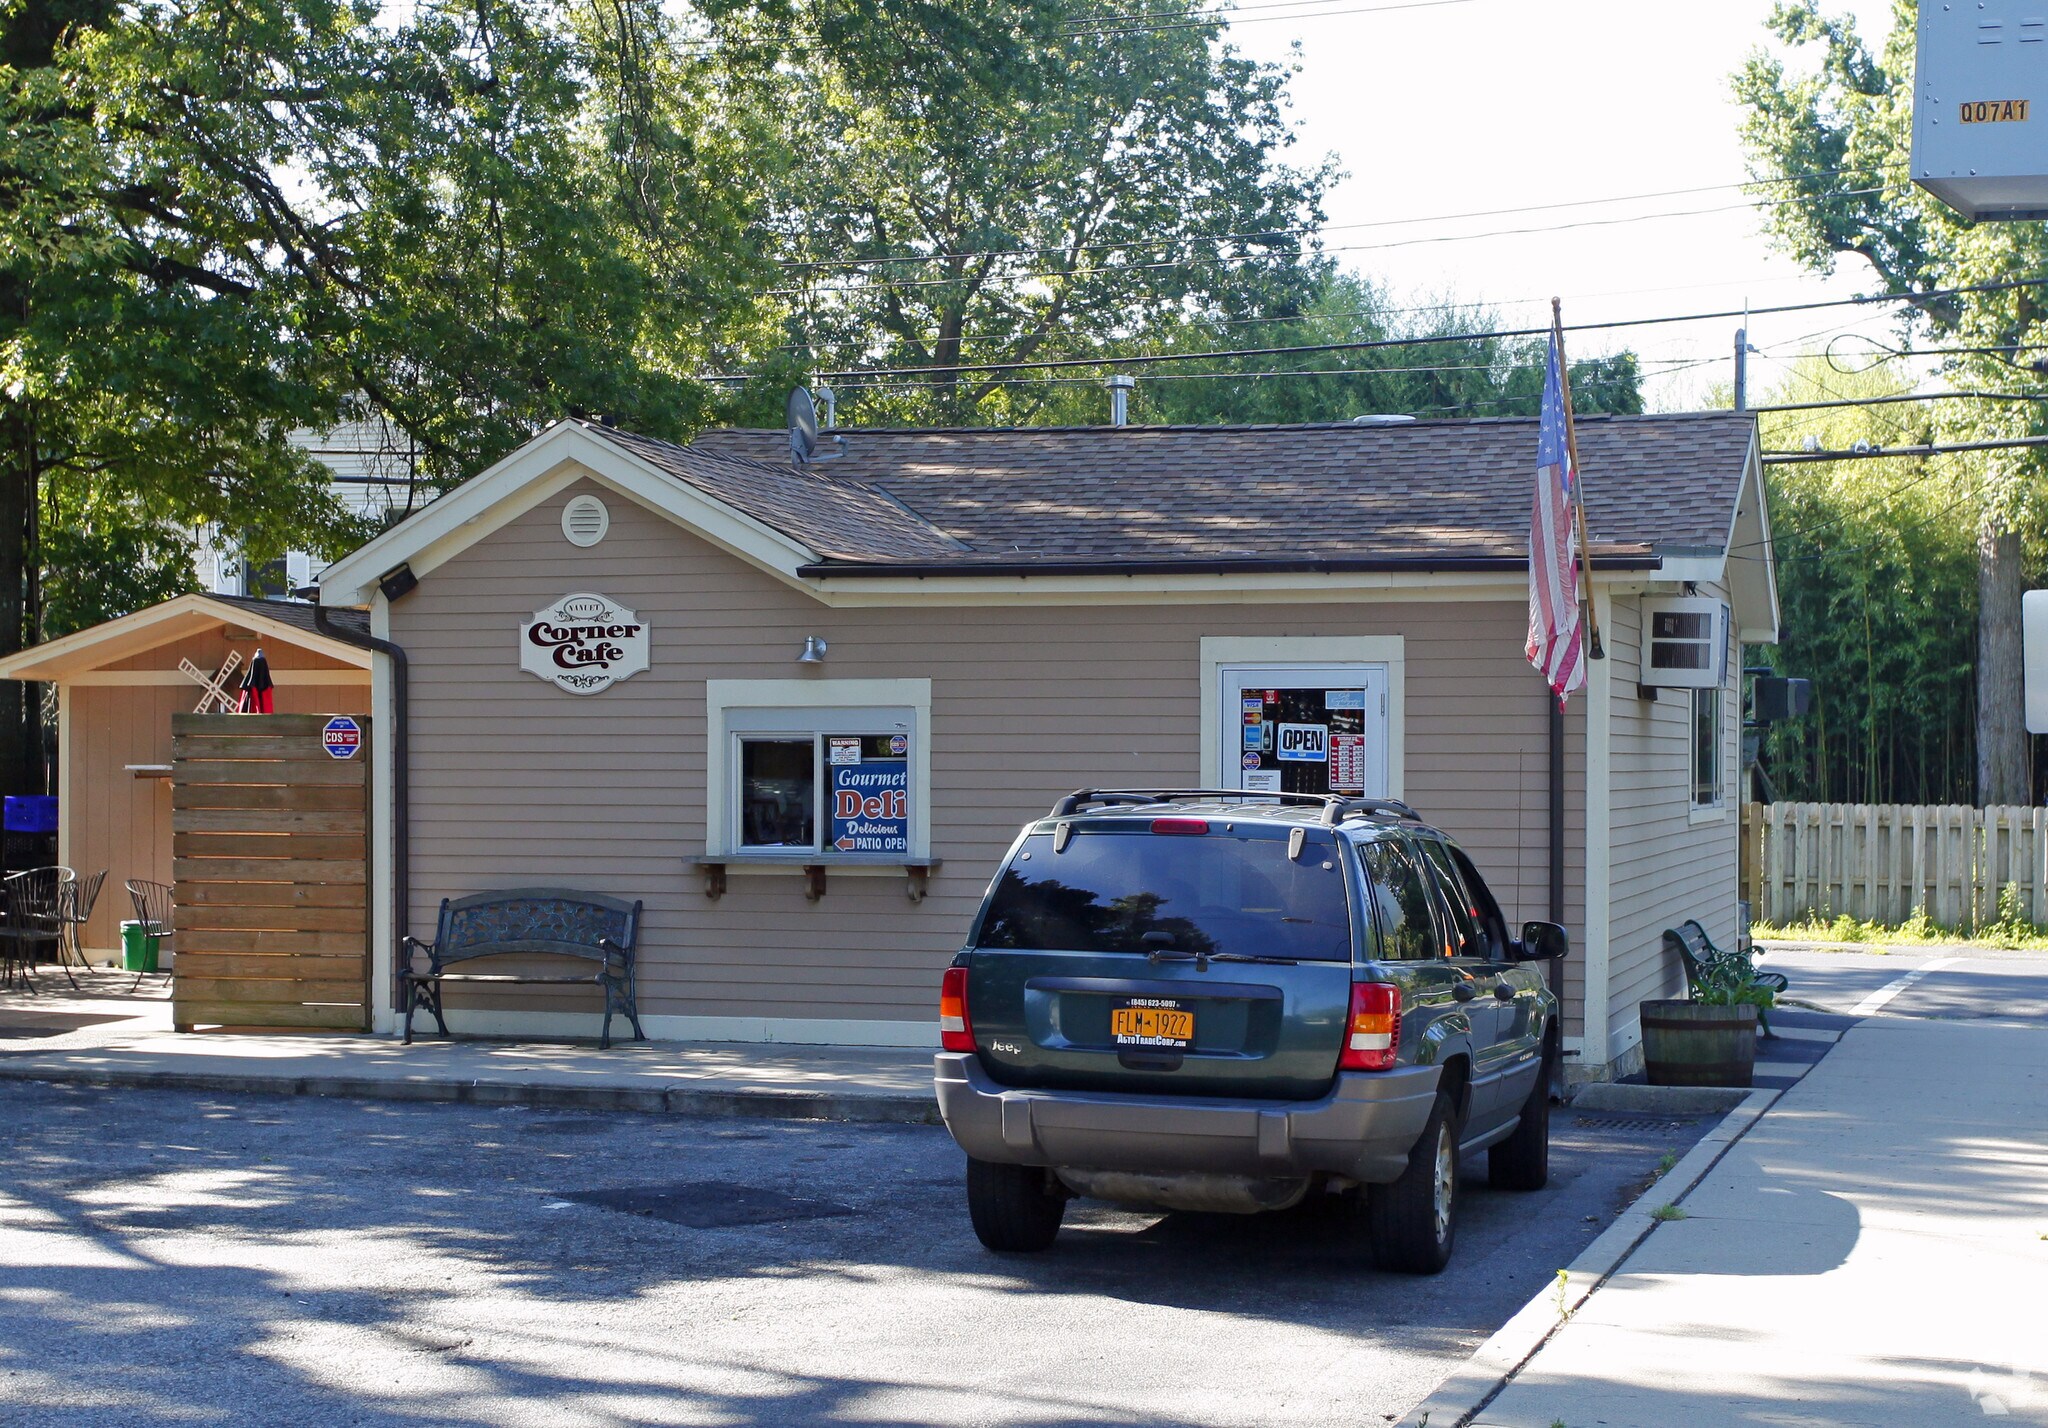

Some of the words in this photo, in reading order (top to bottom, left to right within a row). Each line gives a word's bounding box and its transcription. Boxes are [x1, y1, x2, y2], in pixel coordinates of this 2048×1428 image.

[528, 622, 641, 647] Corner
[552, 642, 624, 669] Cafe
[325, 732, 343, 742] CDS
[1282, 729, 1323, 751] OPEN
[838, 769, 907, 786] Gourmet
[834, 789, 907, 819] Deli
[846, 820, 898, 835] Delicious
[856, 837, 882, 850] PATIO
[1147, 999, 1176, 1008] 623-5097
[992, 1039, 1022, 1055] Jeep
